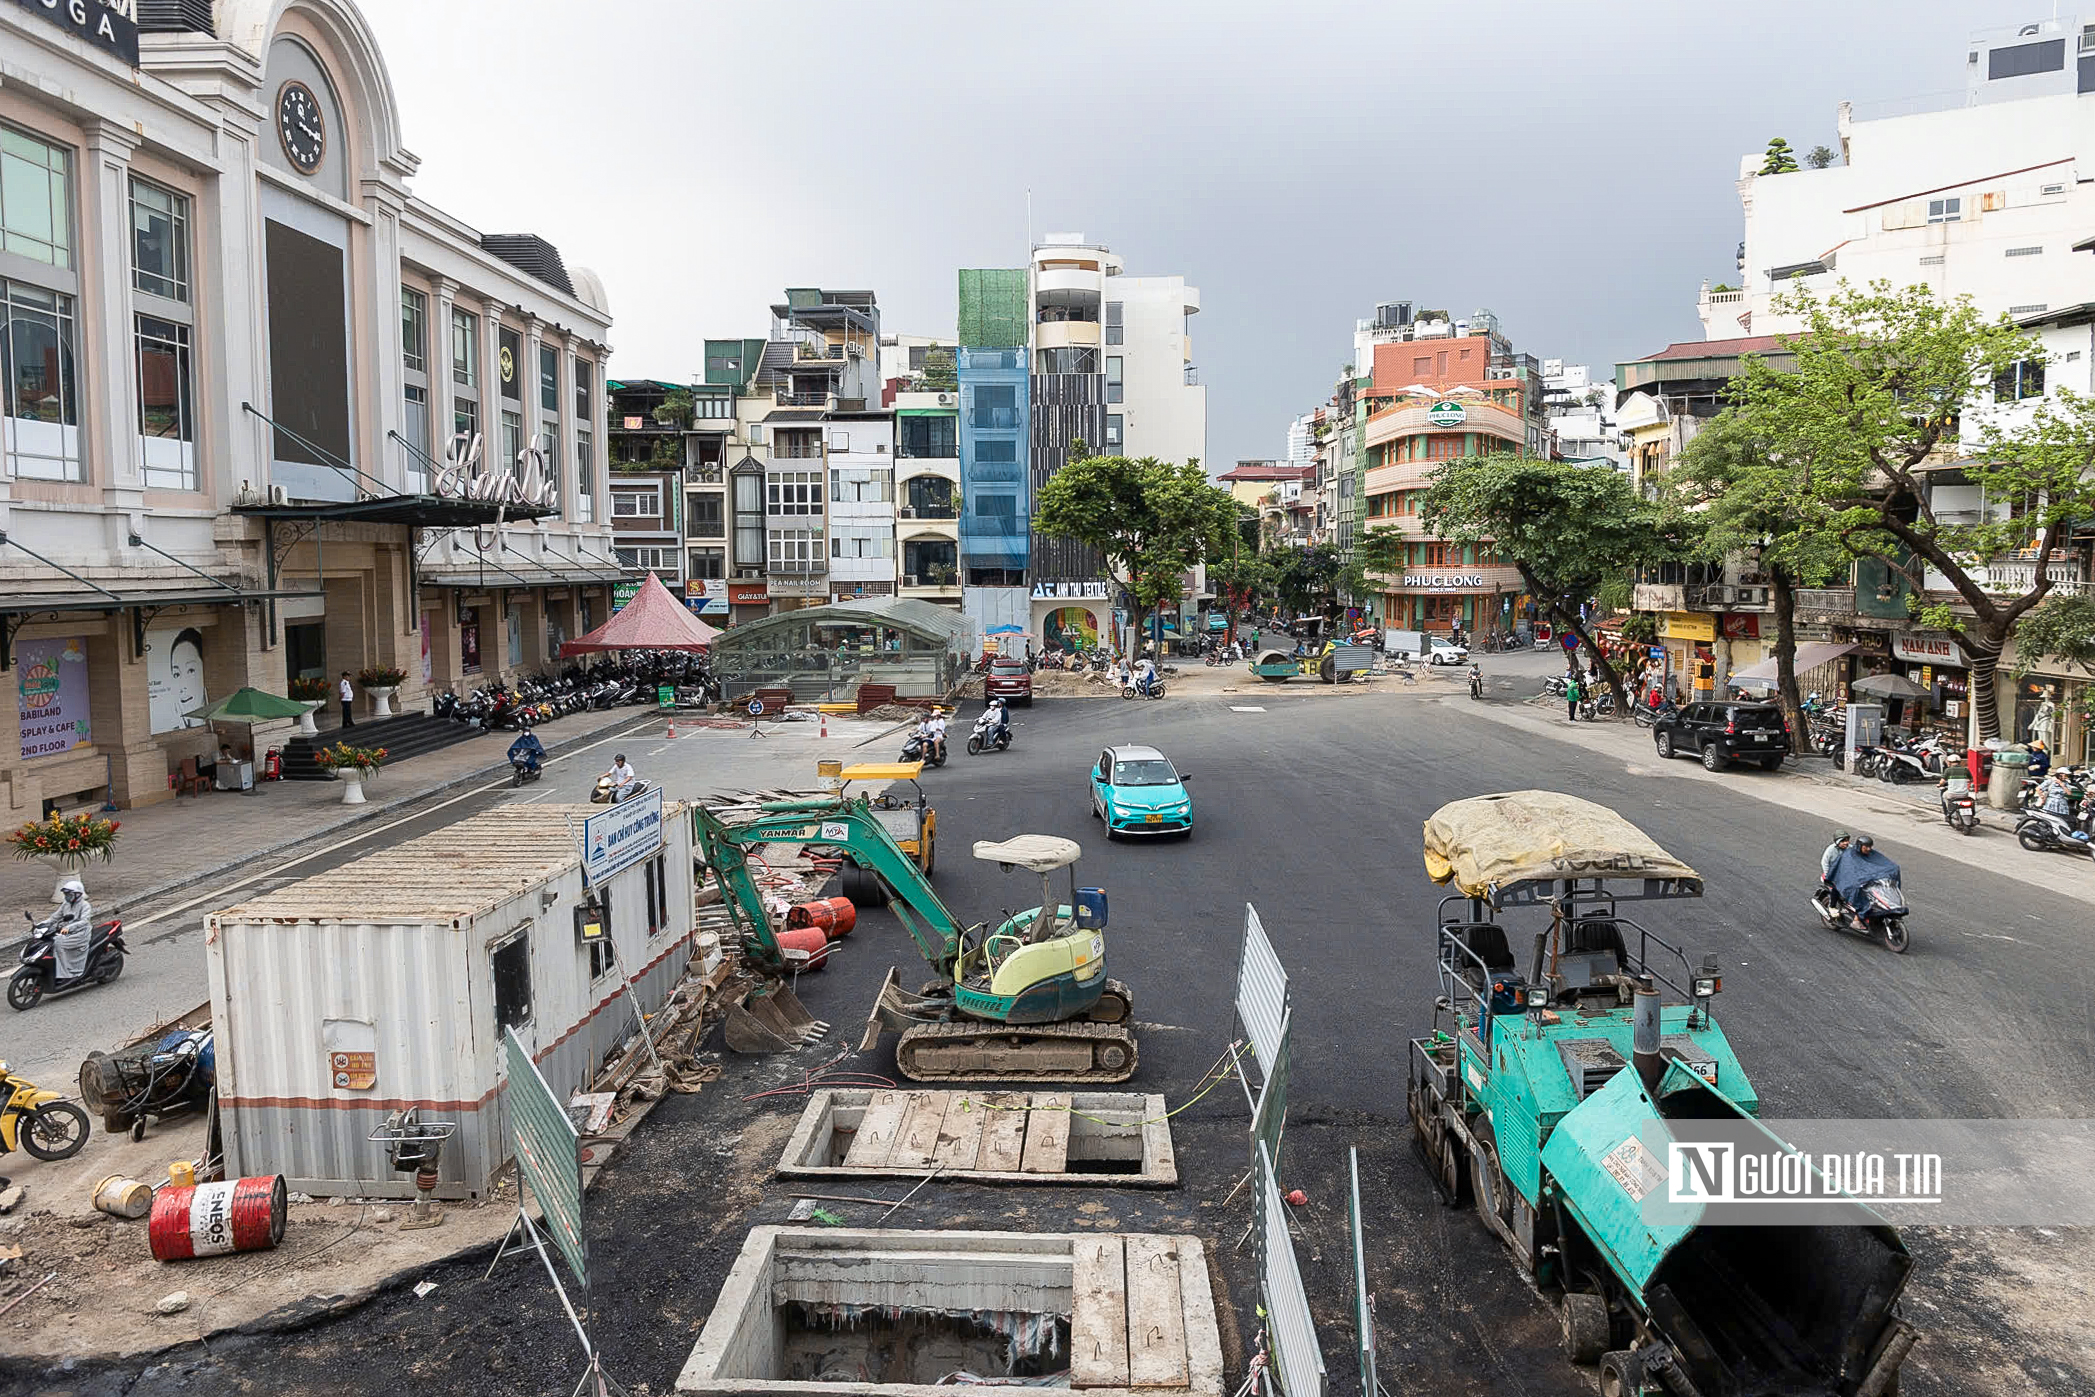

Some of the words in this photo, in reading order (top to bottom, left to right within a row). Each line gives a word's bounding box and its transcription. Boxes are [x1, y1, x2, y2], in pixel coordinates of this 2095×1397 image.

[1444, 575, 1483, 586] LONG
[1901, 638, 1925, 653] NAM
[1927, 640, 1951, 656] ANH
[20, 725, 47, 739] SPLAY
[20, 745, 38, 756] 2ND
[39, 740, 66, 753] FLOOR
[760, 829, 805, 838] YANMAR
[209, 1191, 226, 1244] ENEOS
